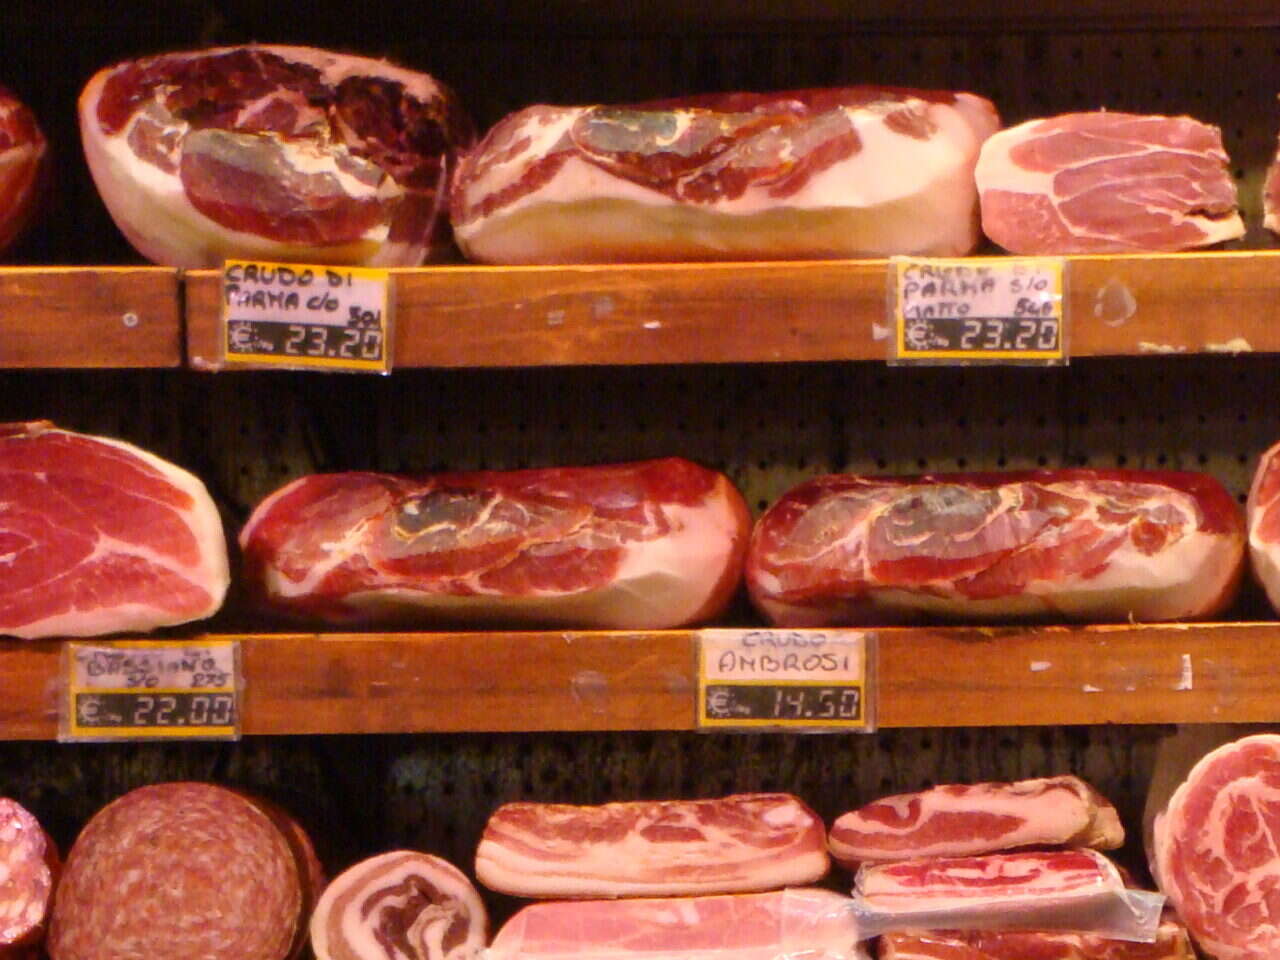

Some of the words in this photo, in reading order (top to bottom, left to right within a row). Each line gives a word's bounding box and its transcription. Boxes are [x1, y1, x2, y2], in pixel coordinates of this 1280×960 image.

[226, 264, 313, 286] CRUDO
[326, 270, 352, 287] DI
[904, 278, 995, 299] PARMA
[226, 284, 299, 310] PARMA
[286, 325, 382, 359] 23.20
[960, 320, 1058, 349] 23.20
[742, 632, 827, 648] CRUDO
[134, 696, 232, 725] 22.00
[774, 690, 858, 717] 14.50
